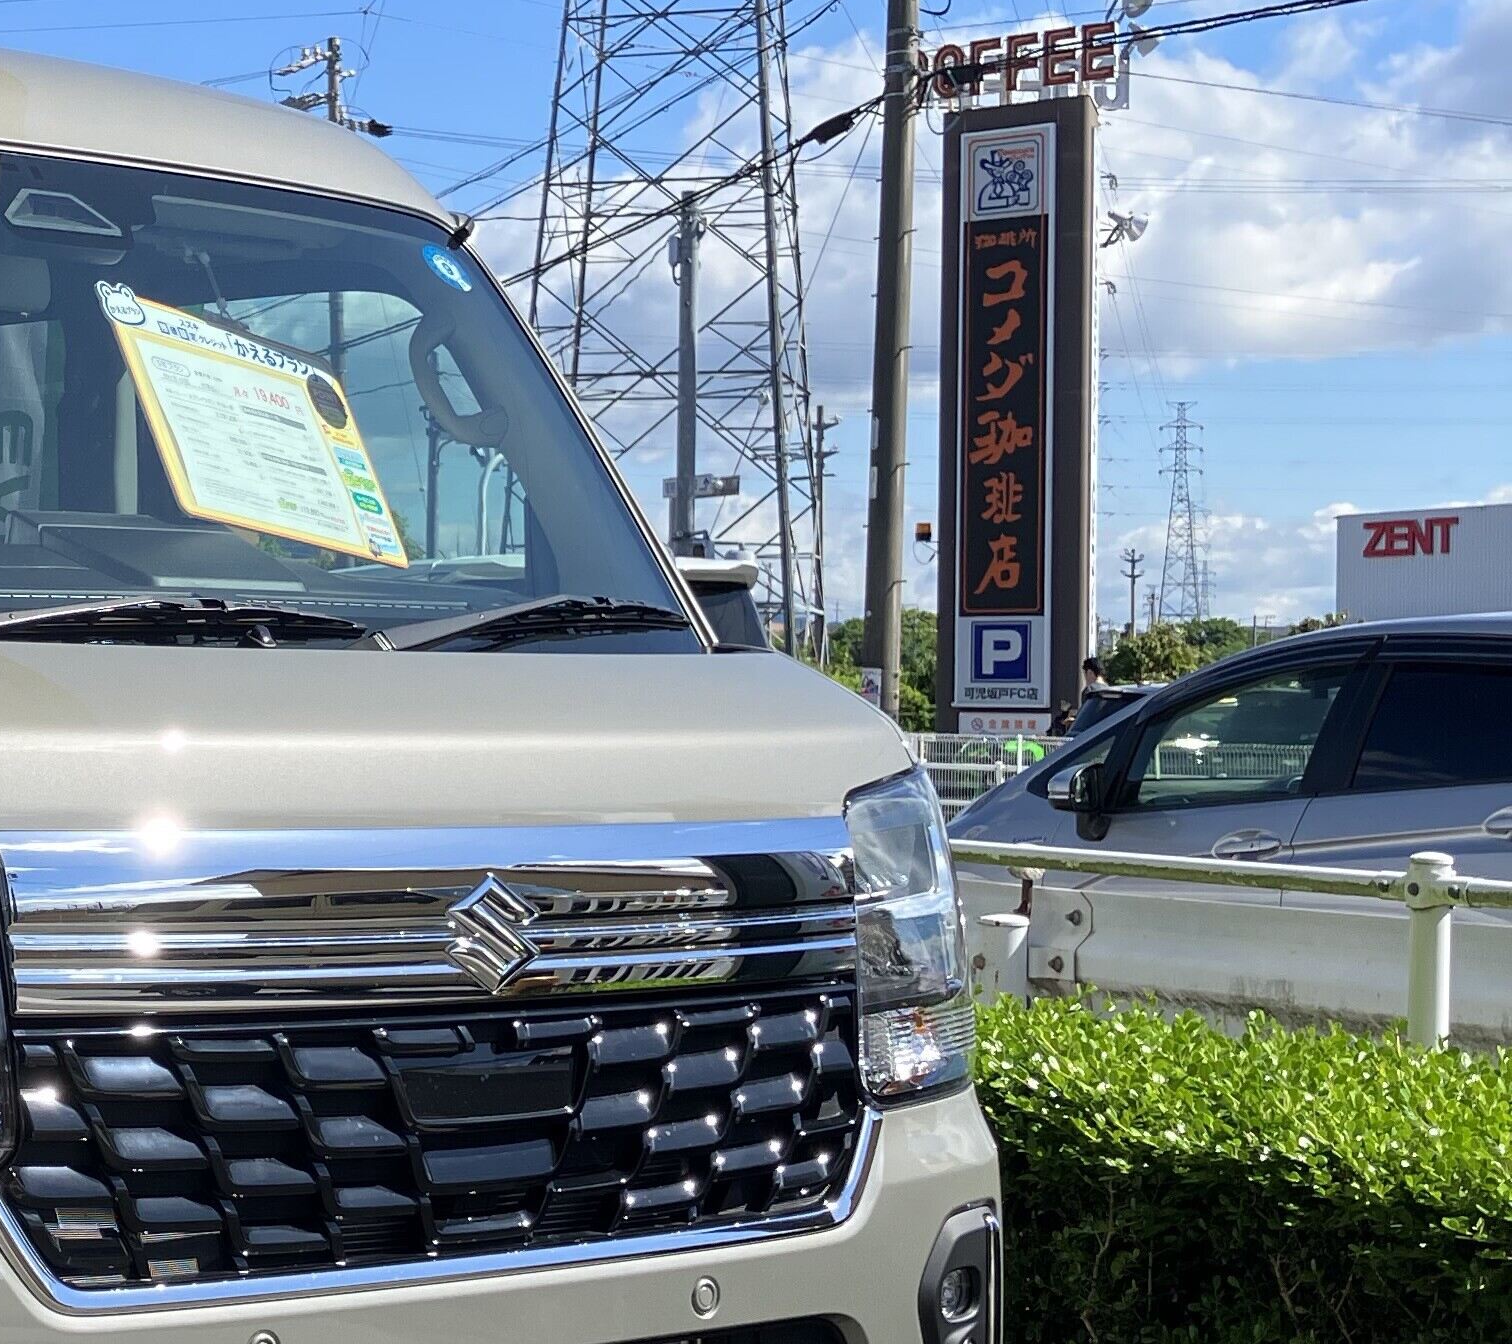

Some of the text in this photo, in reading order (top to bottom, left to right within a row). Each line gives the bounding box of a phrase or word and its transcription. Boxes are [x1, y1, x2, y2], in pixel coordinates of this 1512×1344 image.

[918, 21, 1116, 104] OFFEE
[968, 259, 1033, 595] コメダ珈琲店
[1363, 516, 1459, 557] ZENT
[981, 629, 1022, 675] P
